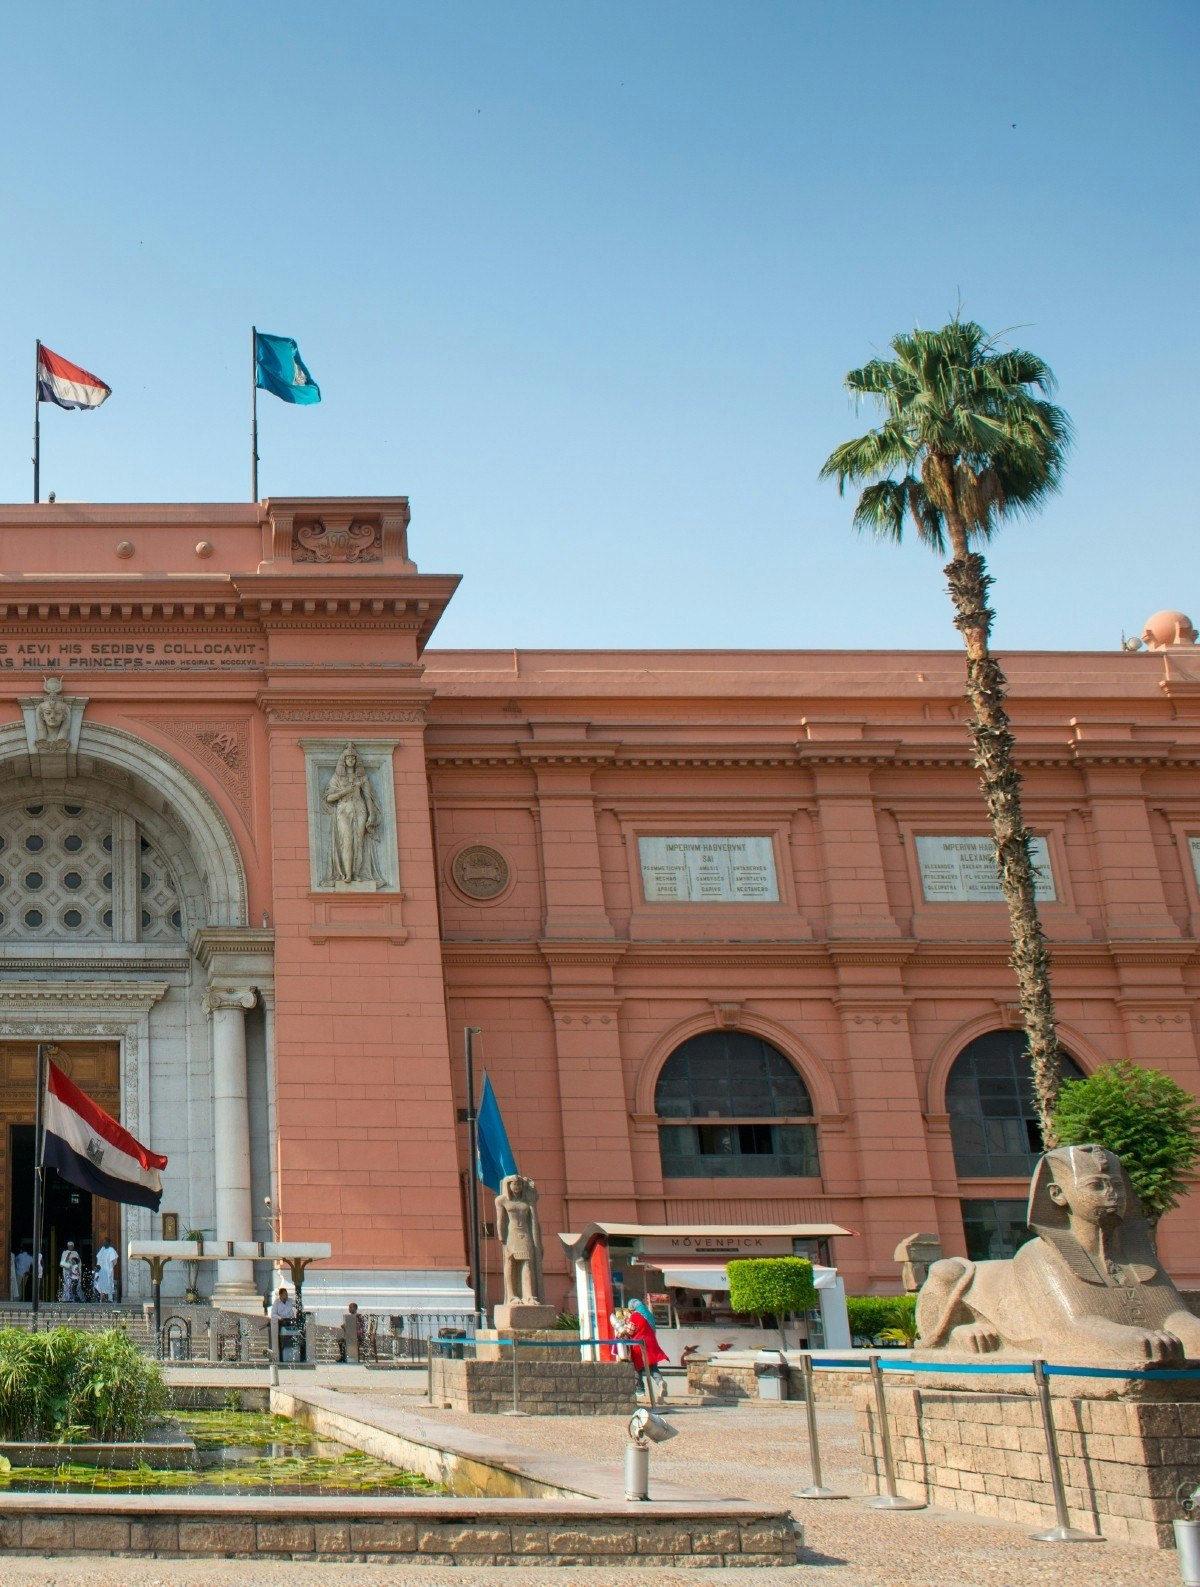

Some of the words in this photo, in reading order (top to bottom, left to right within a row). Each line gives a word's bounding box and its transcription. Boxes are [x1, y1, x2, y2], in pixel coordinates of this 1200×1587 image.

[17, 645, 51, 655] AEVI
[59, 645, 82, 655] HIS
[91, 644, 155, 655] SEDIBVS
[164, 644, 256, 654] COLLOCAVIT
[22, 658, 61, 667] HILMI
[69, 657, 144, 667] PRINCEPS
[666, 843, 701, 851] IMPERIVM
[703, 843, 746, 851] HABVERVNT
[943, 843, 977, 851] IMPERIVM
[702, 855, 714, 863] SAI
[960, 853, 992, 862] ALEXAN
[671, 1236, 763, 1247] MÖVENPICK
